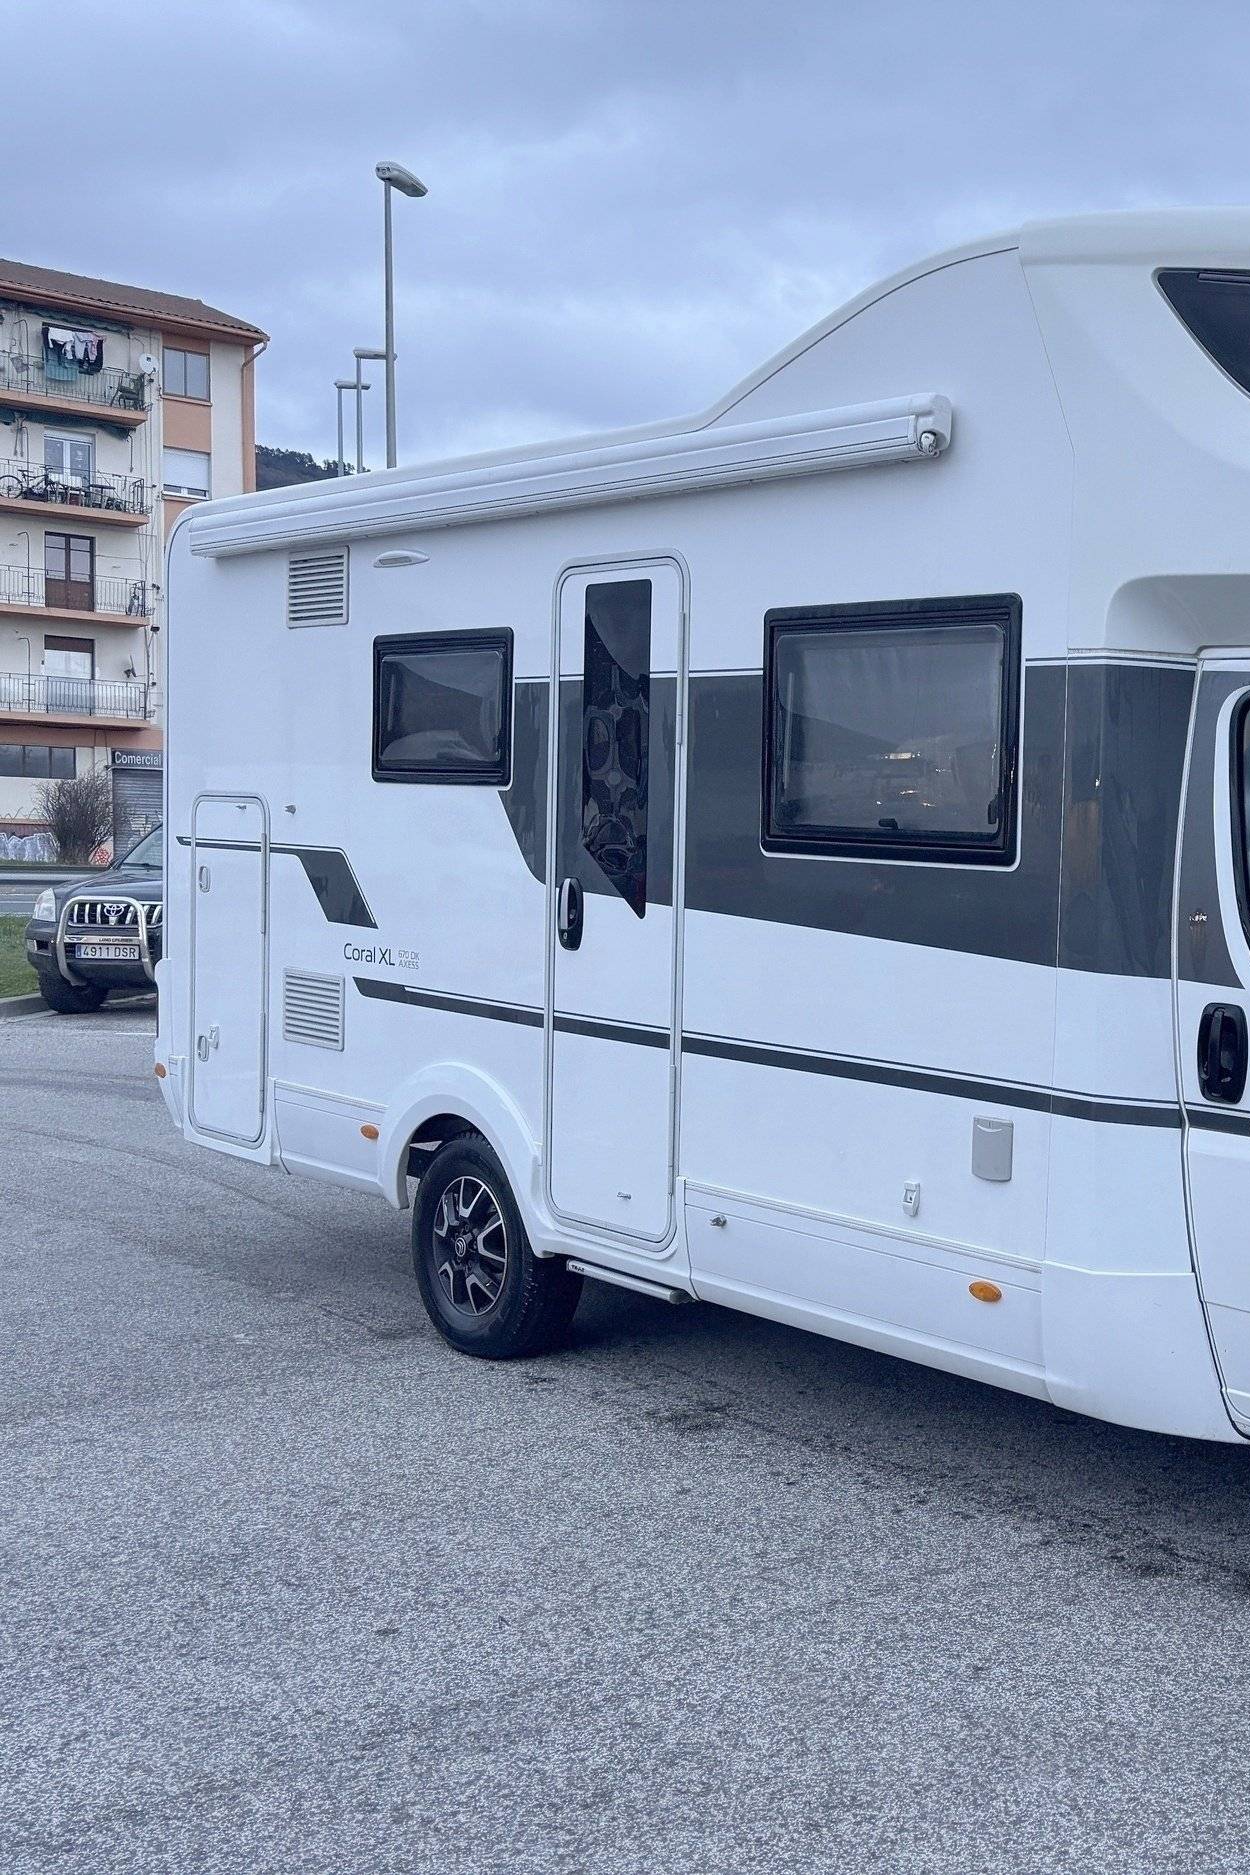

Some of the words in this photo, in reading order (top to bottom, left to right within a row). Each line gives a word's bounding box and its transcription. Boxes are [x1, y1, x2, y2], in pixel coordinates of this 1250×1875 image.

[114, 751, 162, 766] Comercial
[83, 946, 110, 957] 4911
[114, 947, 136, 958] DSR
[343, 943, 376, 963] Coral
[379, 947, 396, 966] XL
